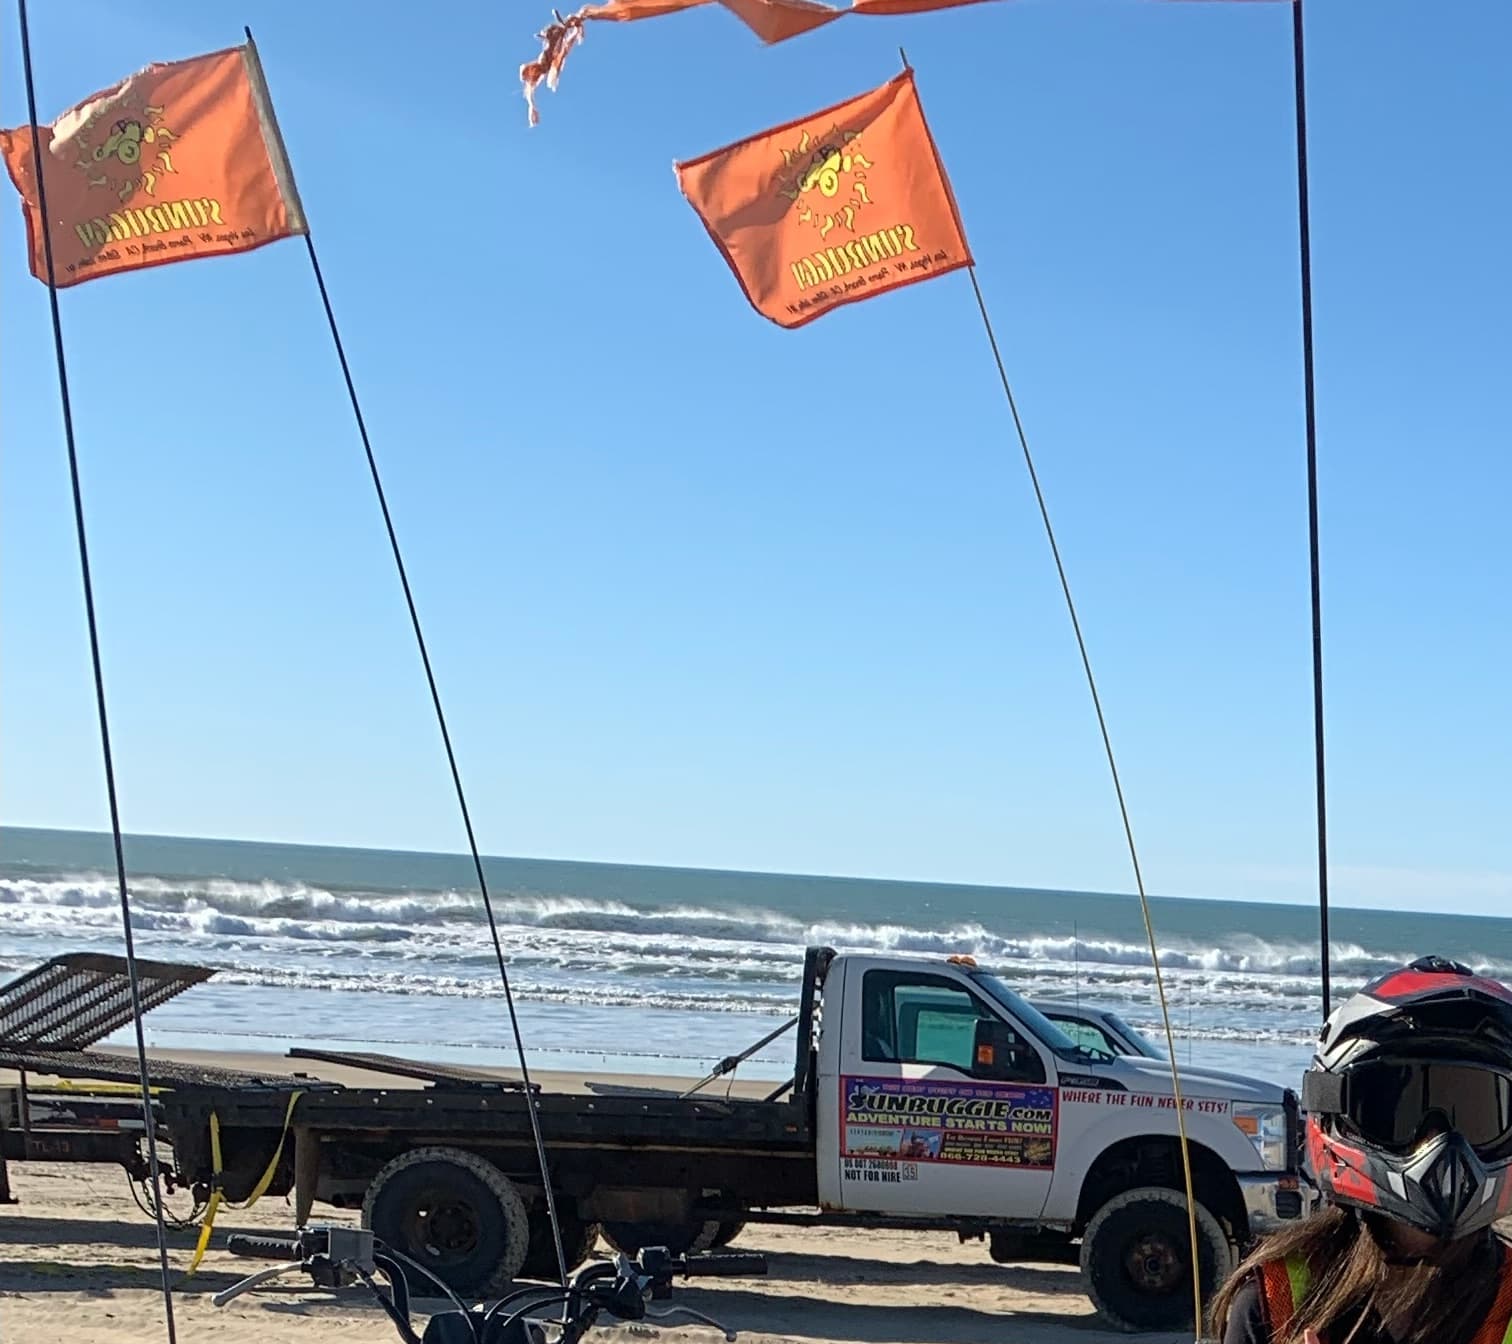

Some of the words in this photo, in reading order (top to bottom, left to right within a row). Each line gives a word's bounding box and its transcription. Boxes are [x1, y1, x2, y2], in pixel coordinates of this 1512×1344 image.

[1062, 1090, 1101, 1104] WHERE
[1106, 1093, 1127, 1106] THE
[1130, 1095, 1153, 1108] FUN
[1198, 1101, 1229, 1114] SETS!
[847, 1112, 941, 1127] ADVENTURE
[944, 1116, 1007, 1131] STARTS
[1011, 1121, 1052, 1134] NOW!
[844, 1169, 861, 1181] NOT
[864, 1170, 879, 1181] FOR
[881, 1171, 901, 1183] HIRE
